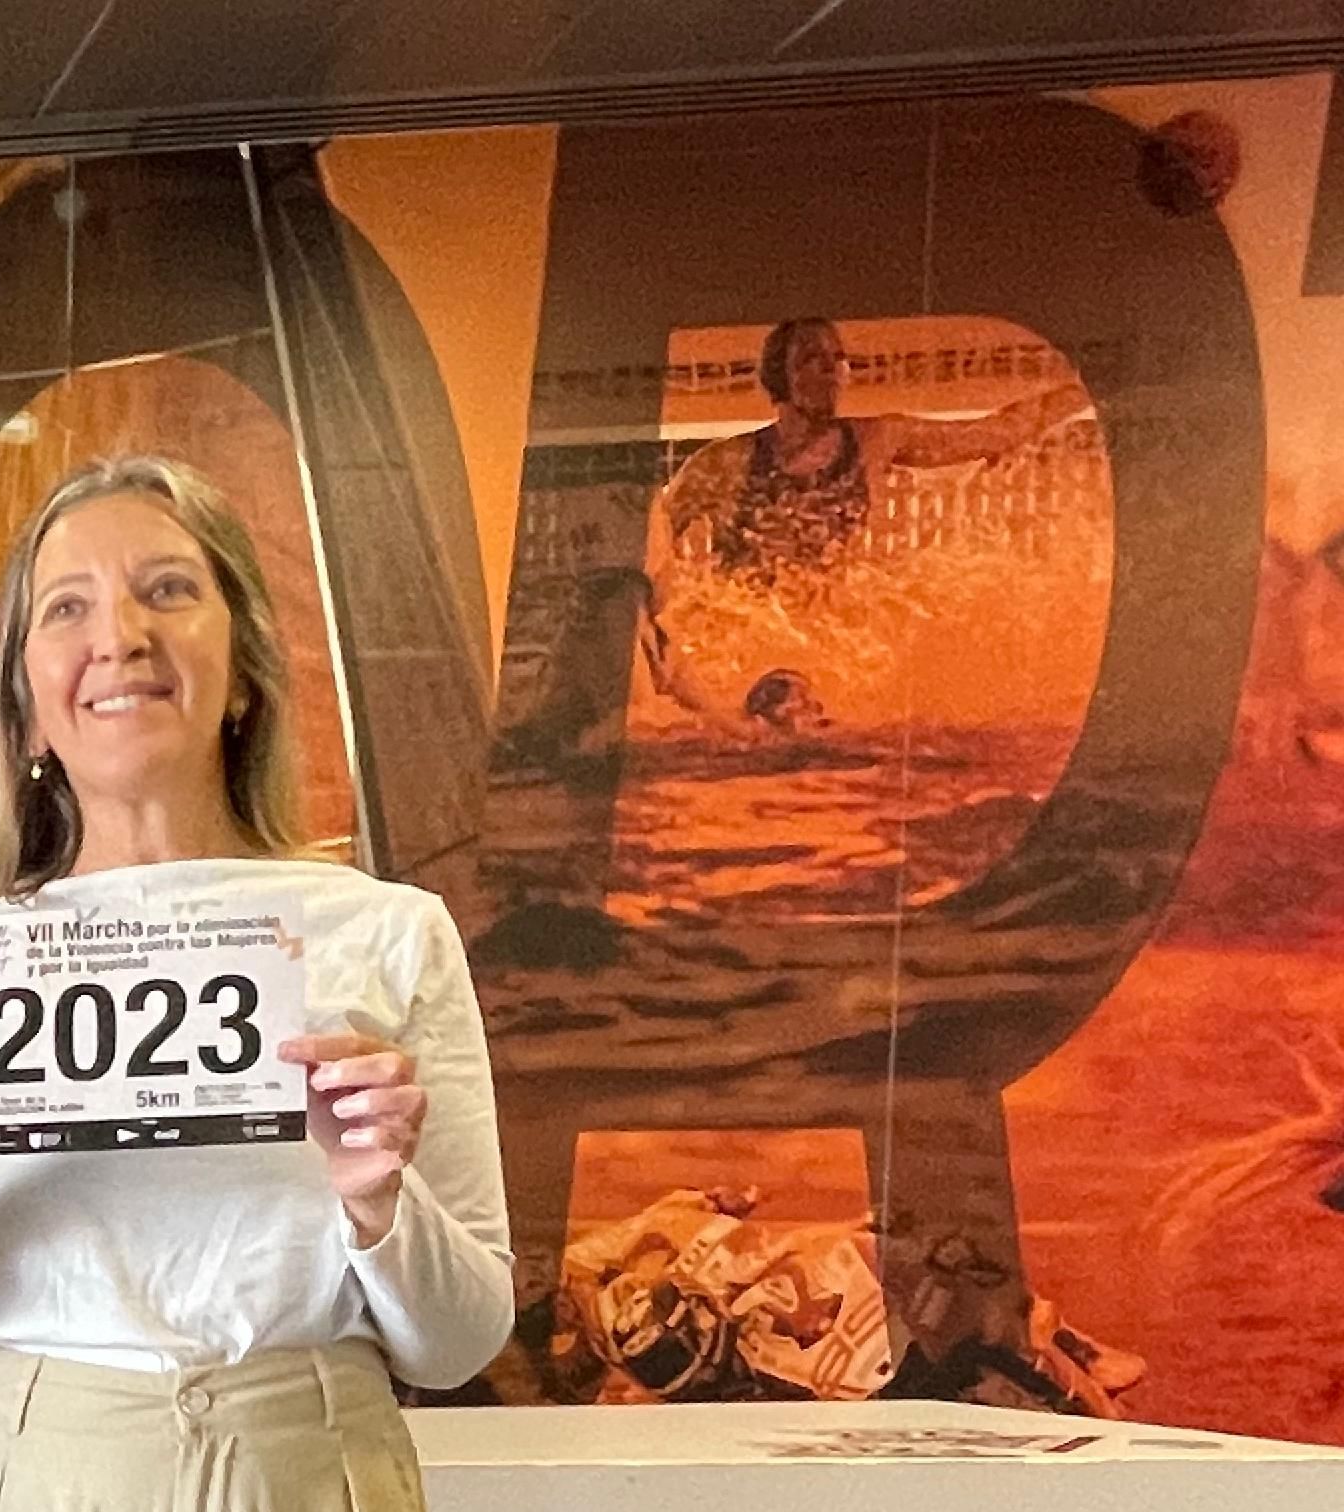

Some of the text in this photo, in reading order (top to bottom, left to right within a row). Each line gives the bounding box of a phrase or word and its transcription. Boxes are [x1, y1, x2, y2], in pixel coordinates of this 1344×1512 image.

[25, 924, 54, 944] VII
[62, 918, 144, 942] Marcha
[136, 1090, 180, 1108] 5km
